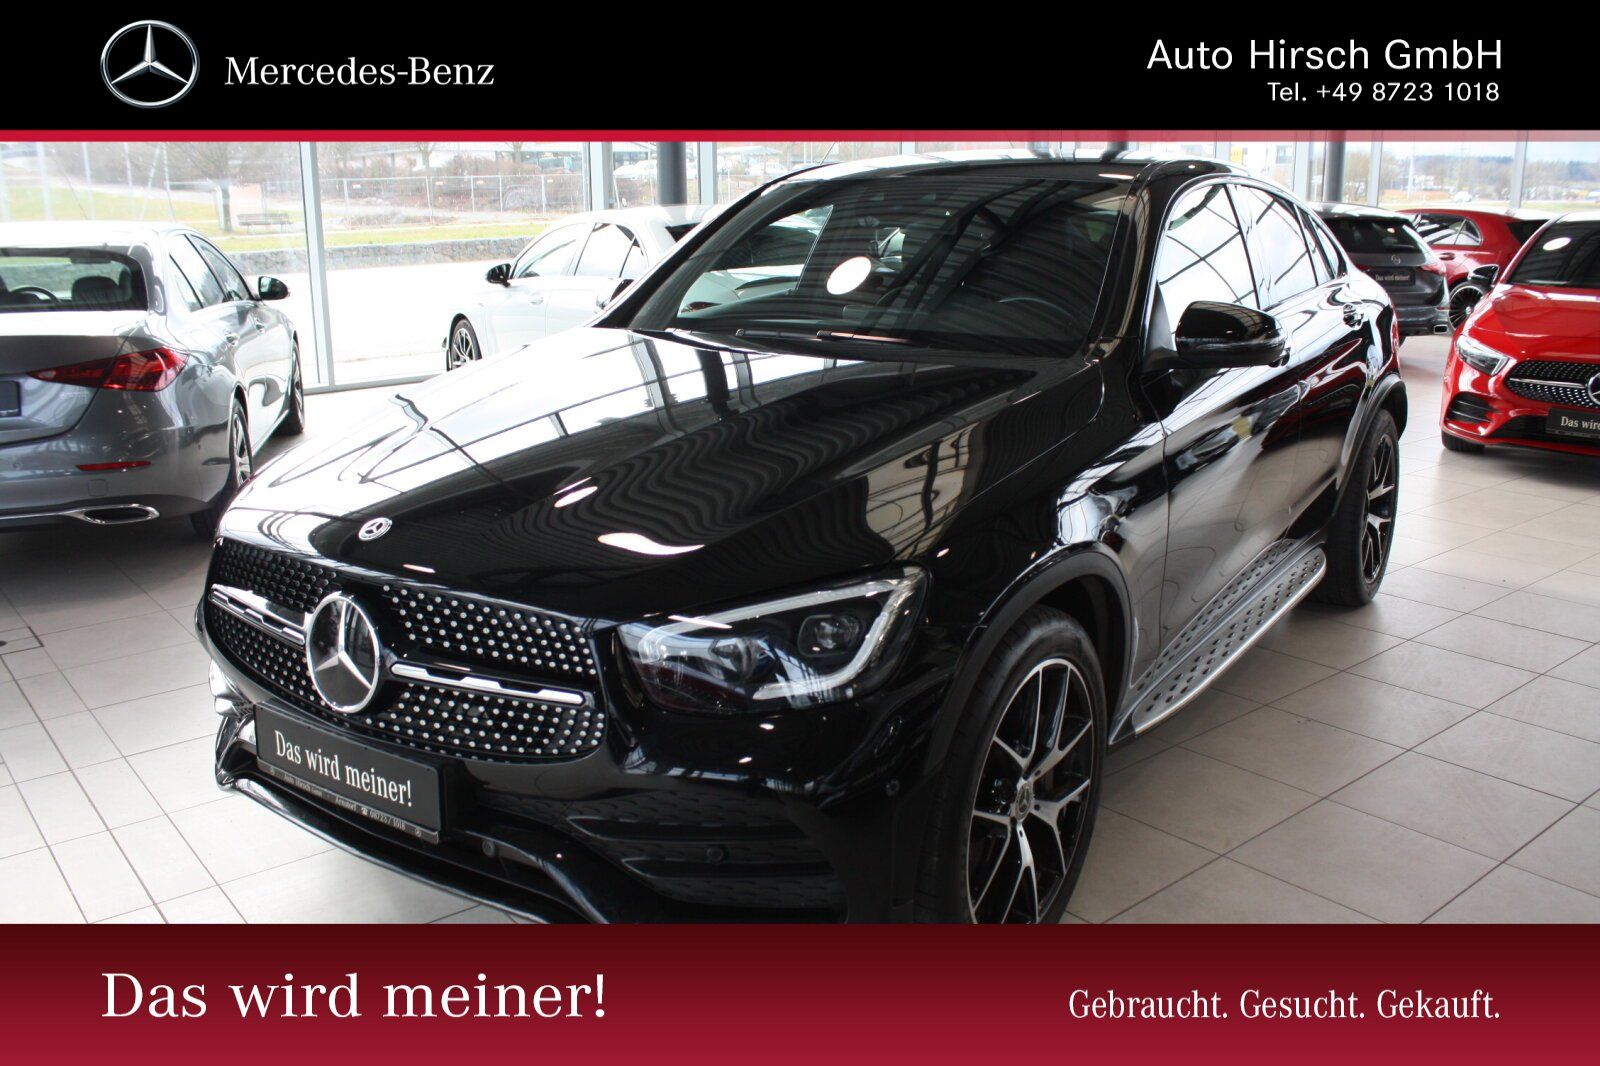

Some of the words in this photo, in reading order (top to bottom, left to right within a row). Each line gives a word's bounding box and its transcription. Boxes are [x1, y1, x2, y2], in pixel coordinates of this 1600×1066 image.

[1561, 416, 1579, 428] Das
[274, 730, 301, 764] Das
[305, 748, 341, 781] wird
[345, 765, 412, 807] meiner!
